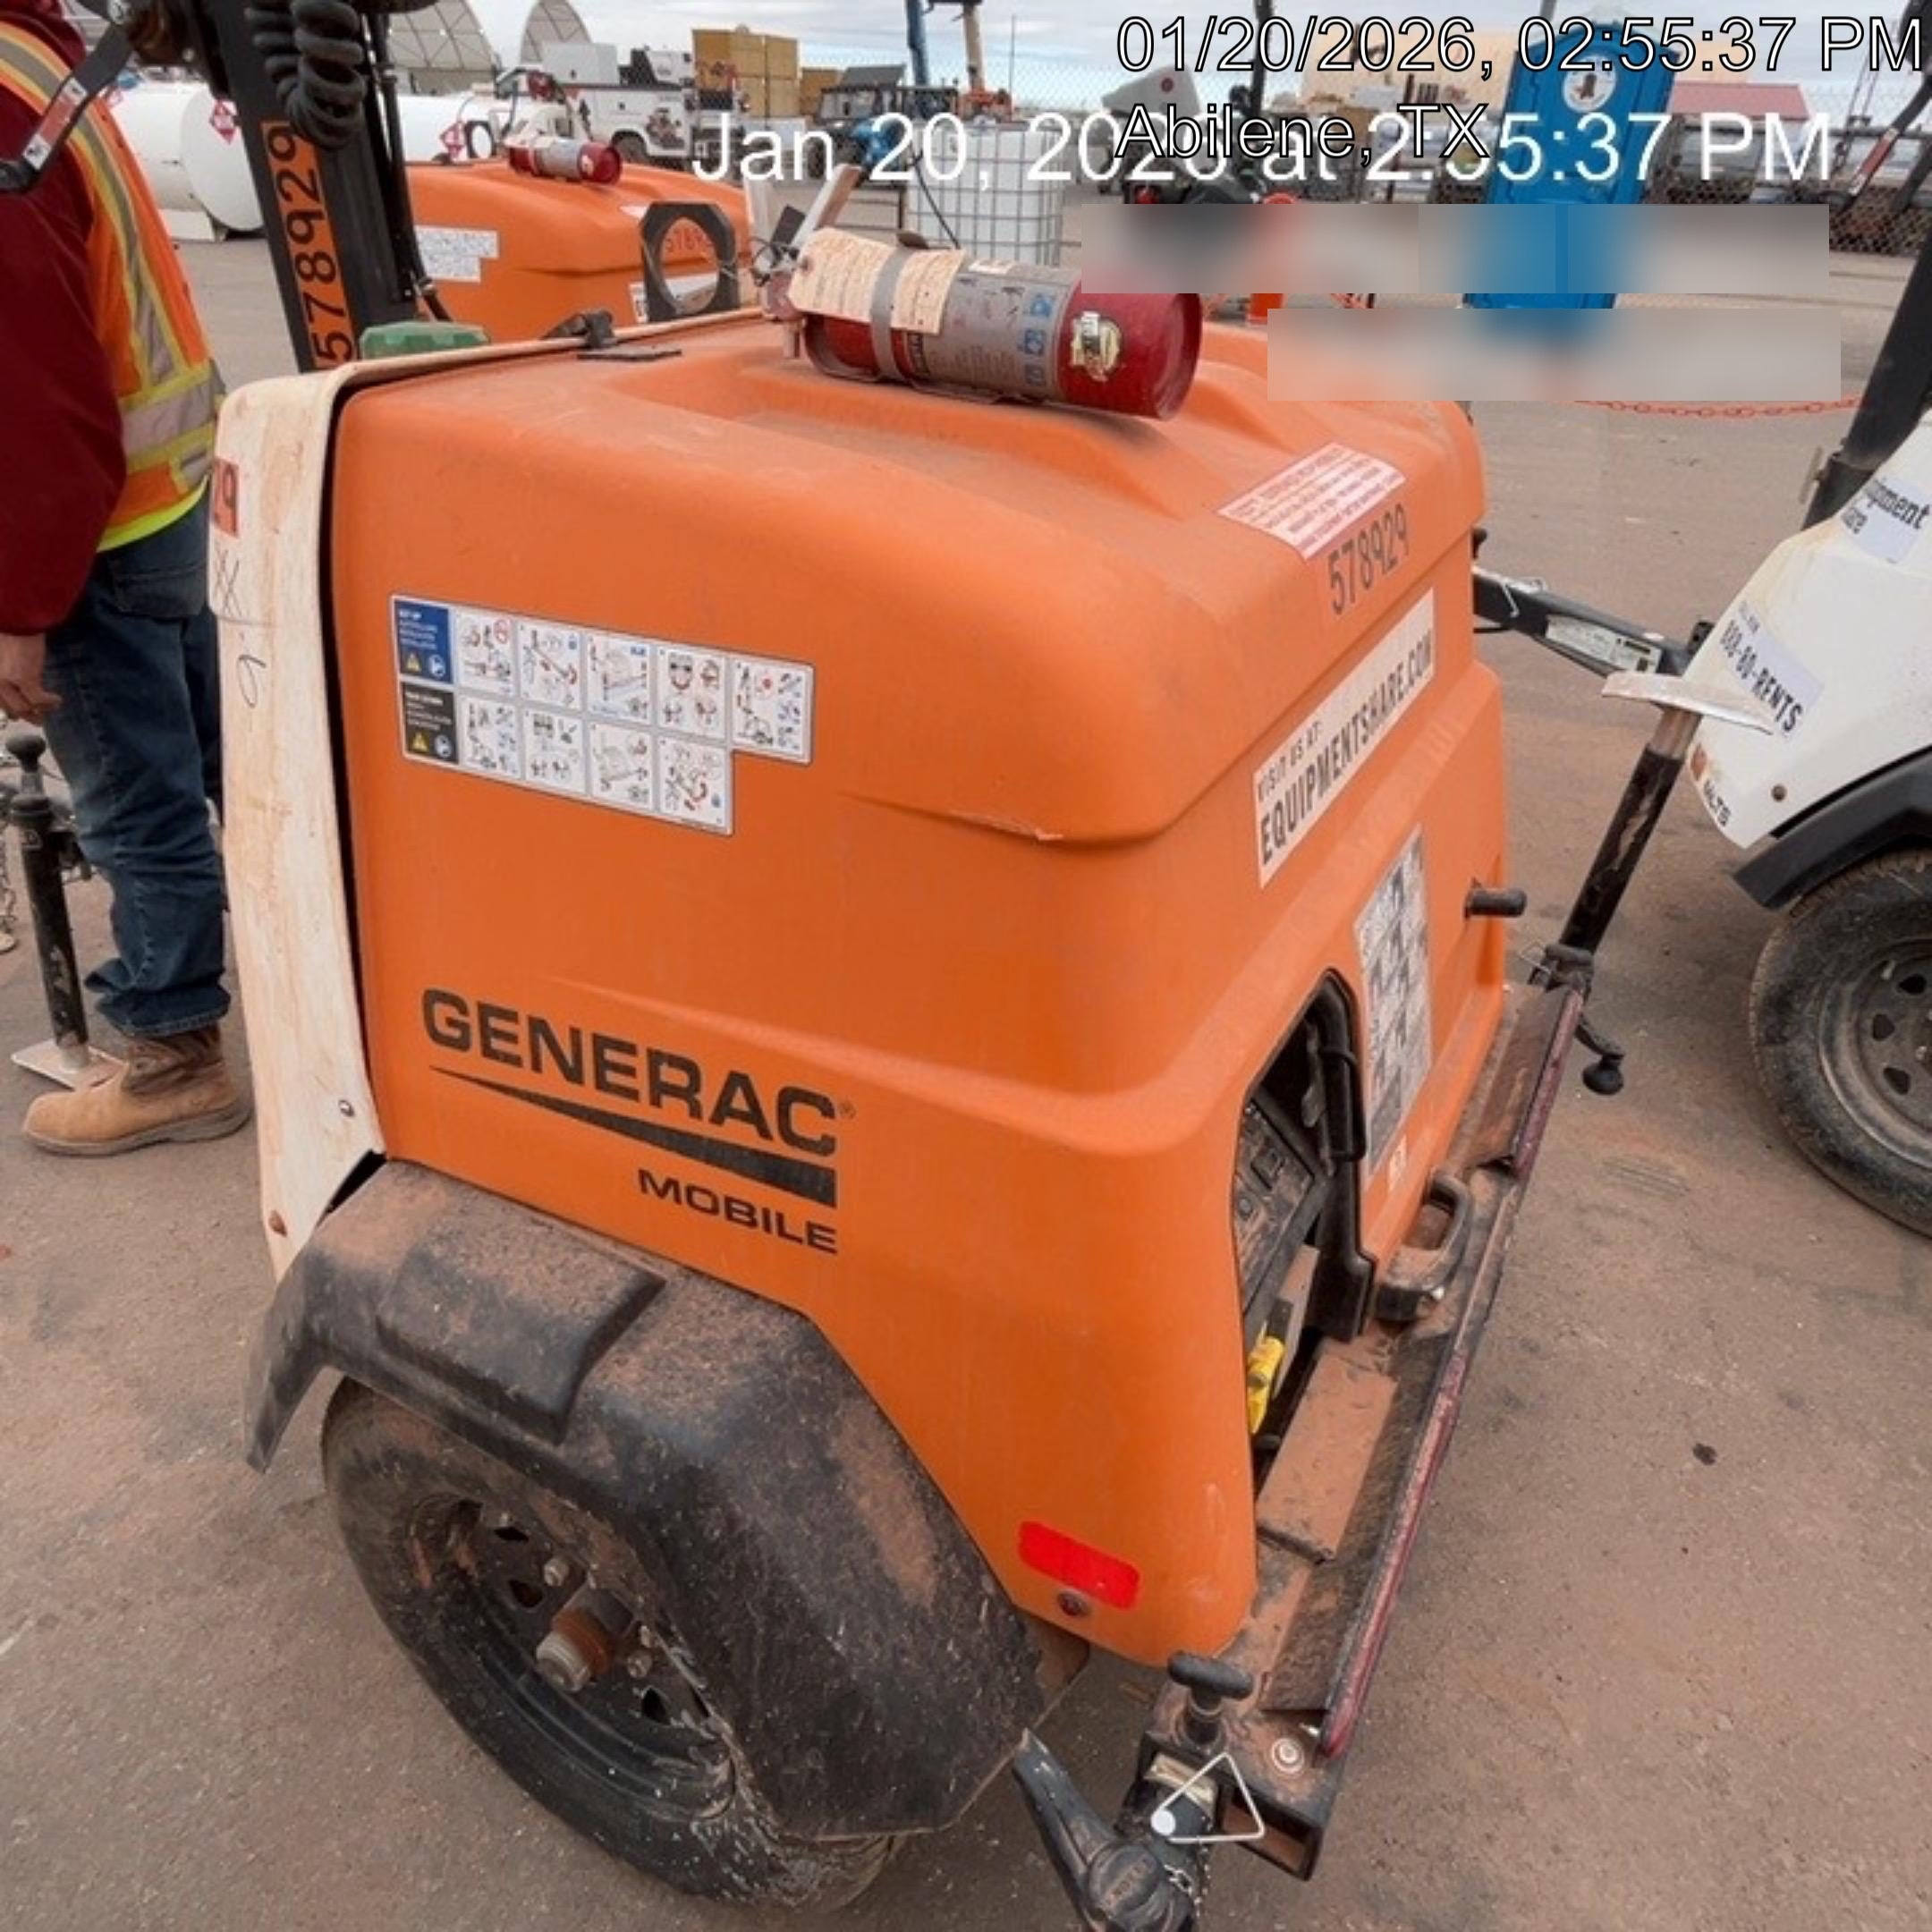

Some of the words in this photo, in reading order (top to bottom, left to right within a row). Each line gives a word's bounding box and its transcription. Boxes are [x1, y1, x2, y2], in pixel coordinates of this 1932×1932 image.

[268, 125, 353, 362] 578929
[1328, 503, 1410, 616] 578929
[1259, 628, 1431, 866] EQUIPMENTSHARE.COM
[639, 1169, 838, 1254] MOBILE
